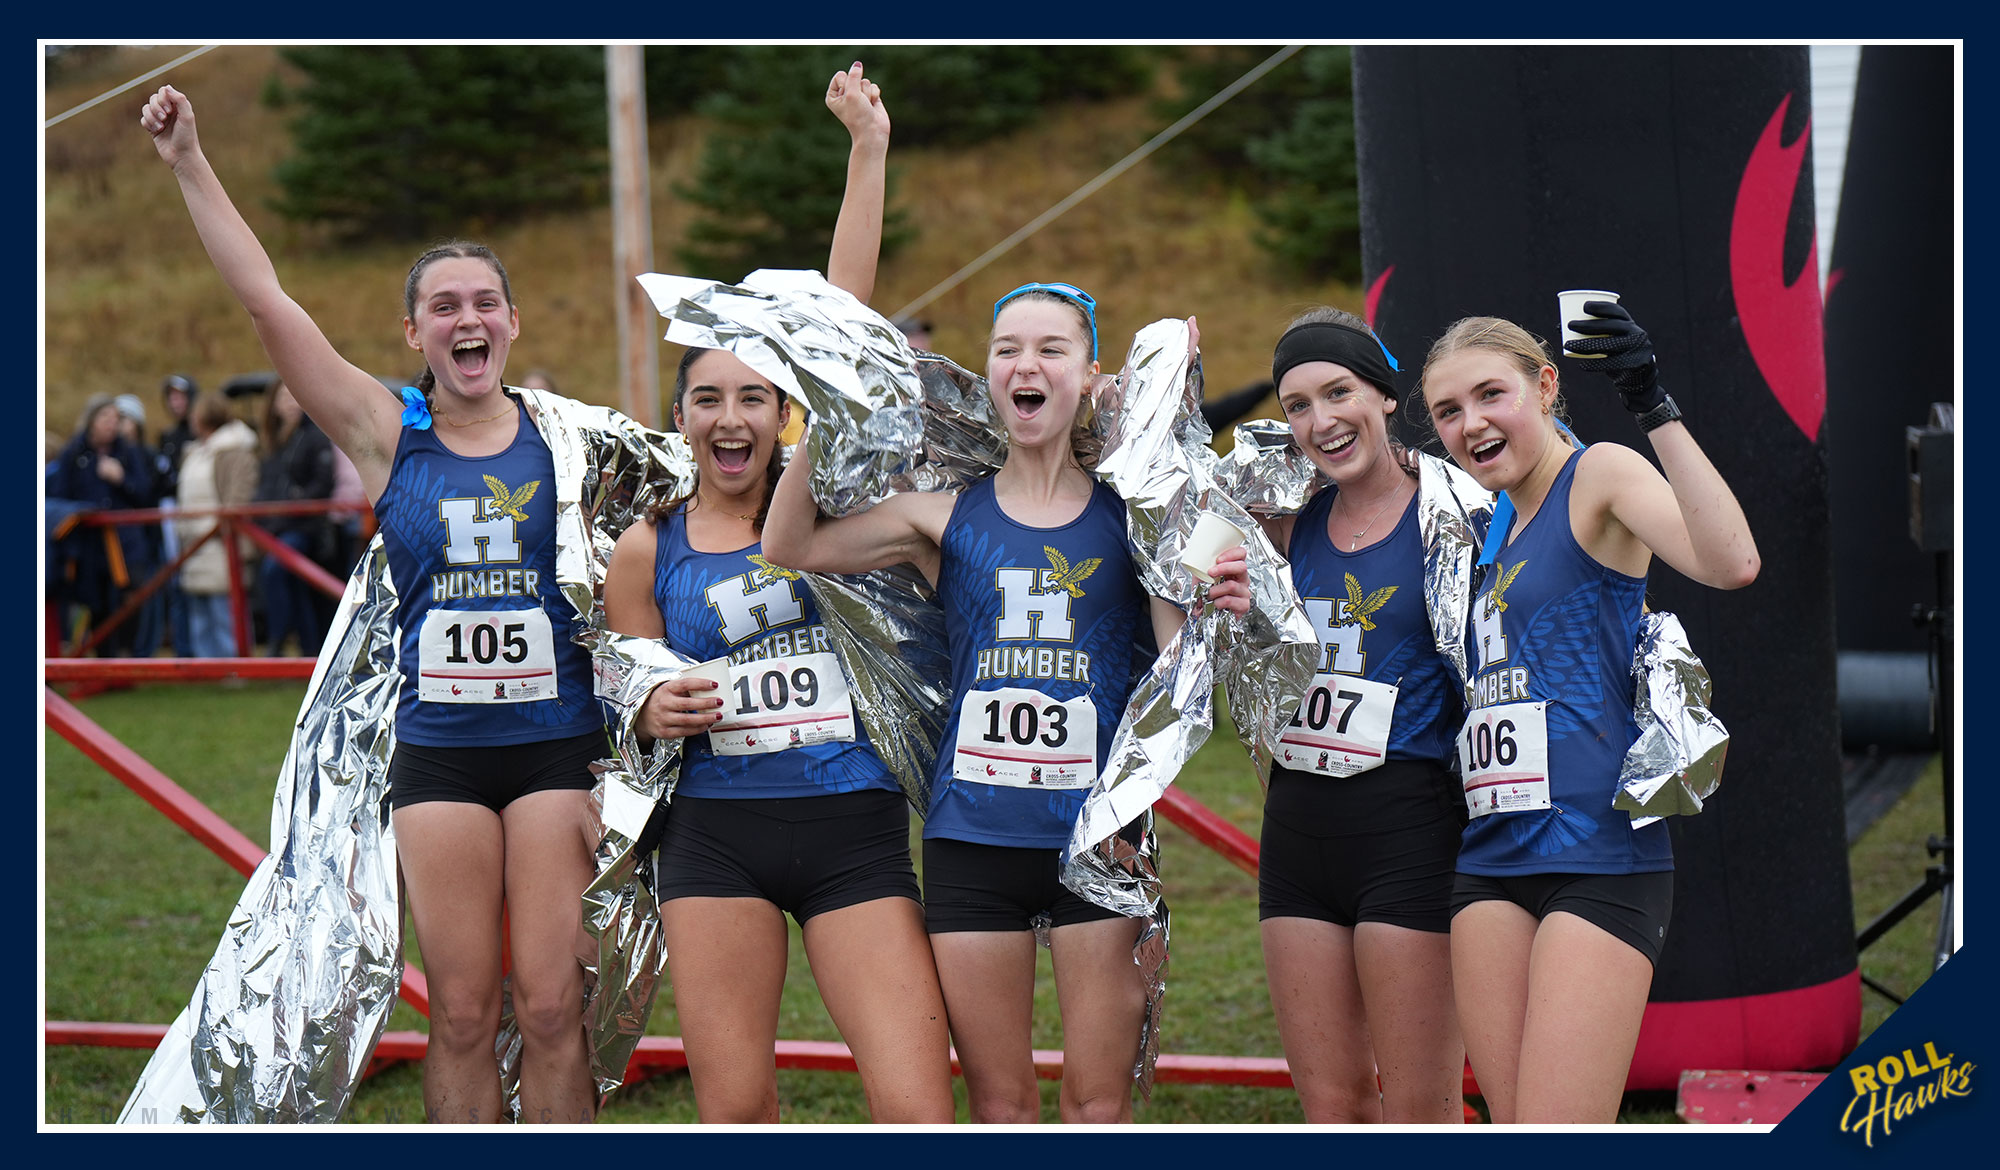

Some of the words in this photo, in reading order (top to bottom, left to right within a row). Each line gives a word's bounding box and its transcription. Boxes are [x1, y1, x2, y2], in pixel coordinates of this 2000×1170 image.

[439, 497, 522, 566] H
[430, 568, 540, 603] HUMBER
[704, 568, 806, 647] H
[995, 567, 1076, 643] H
[445, 622, 528, 665] 105
[1303, 597, 1367, 676] H
[976, 647, 1092, 684] HUMBER
[1474, 666, 1530, 709] MBER
[733, 667, 819, 716] 109
[983, 699, 1069, 748] 103
[1466, 719, 1518, 772] 106
